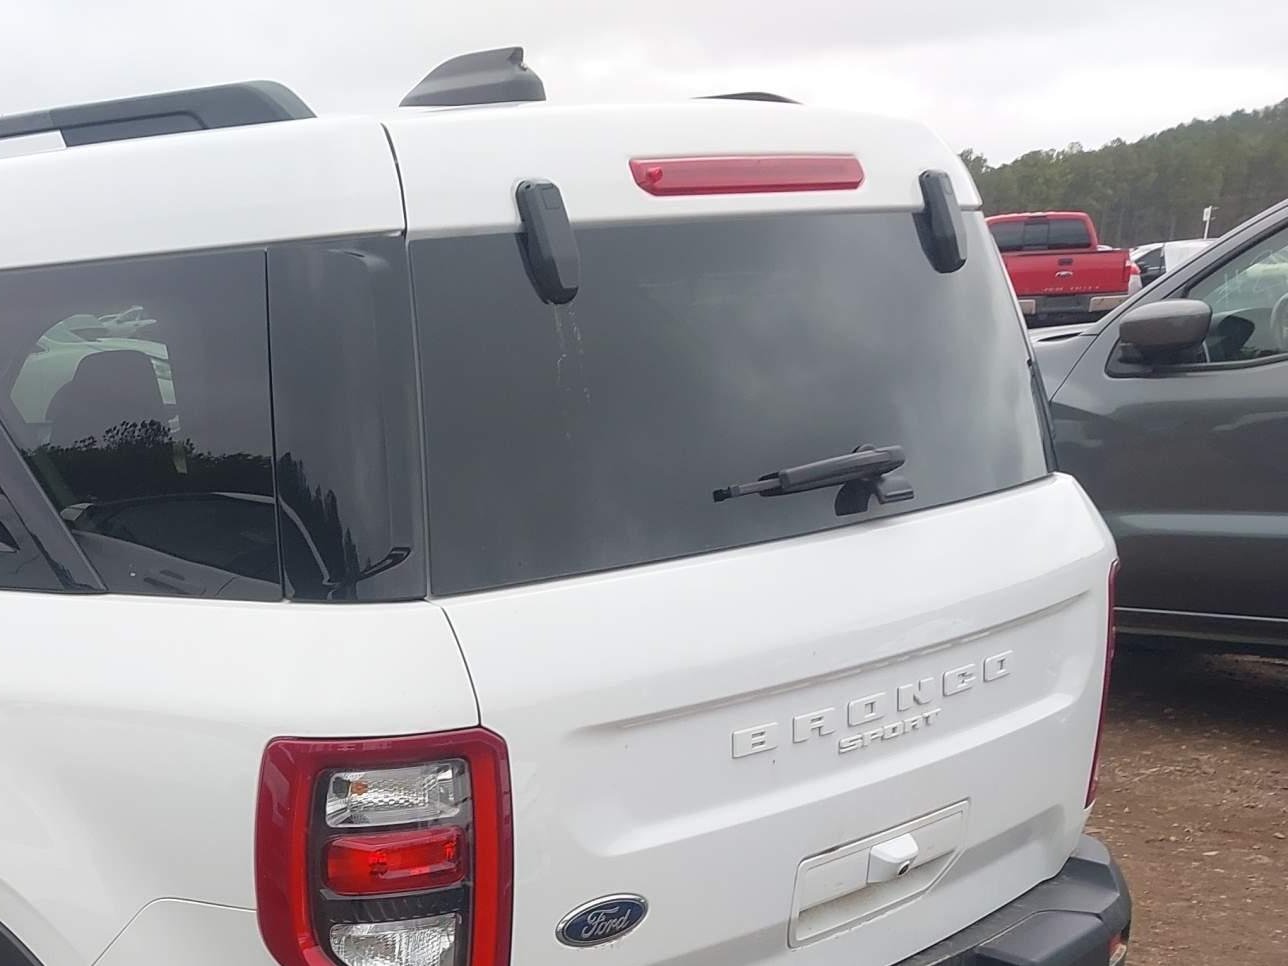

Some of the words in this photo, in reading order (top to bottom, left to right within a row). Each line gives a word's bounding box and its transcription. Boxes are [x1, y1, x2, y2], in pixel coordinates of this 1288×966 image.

[731, 649, 1014, 759] BRONCO
[838, 707, 942, 754] SPORT
[581, 905, 631, 939] Ford
